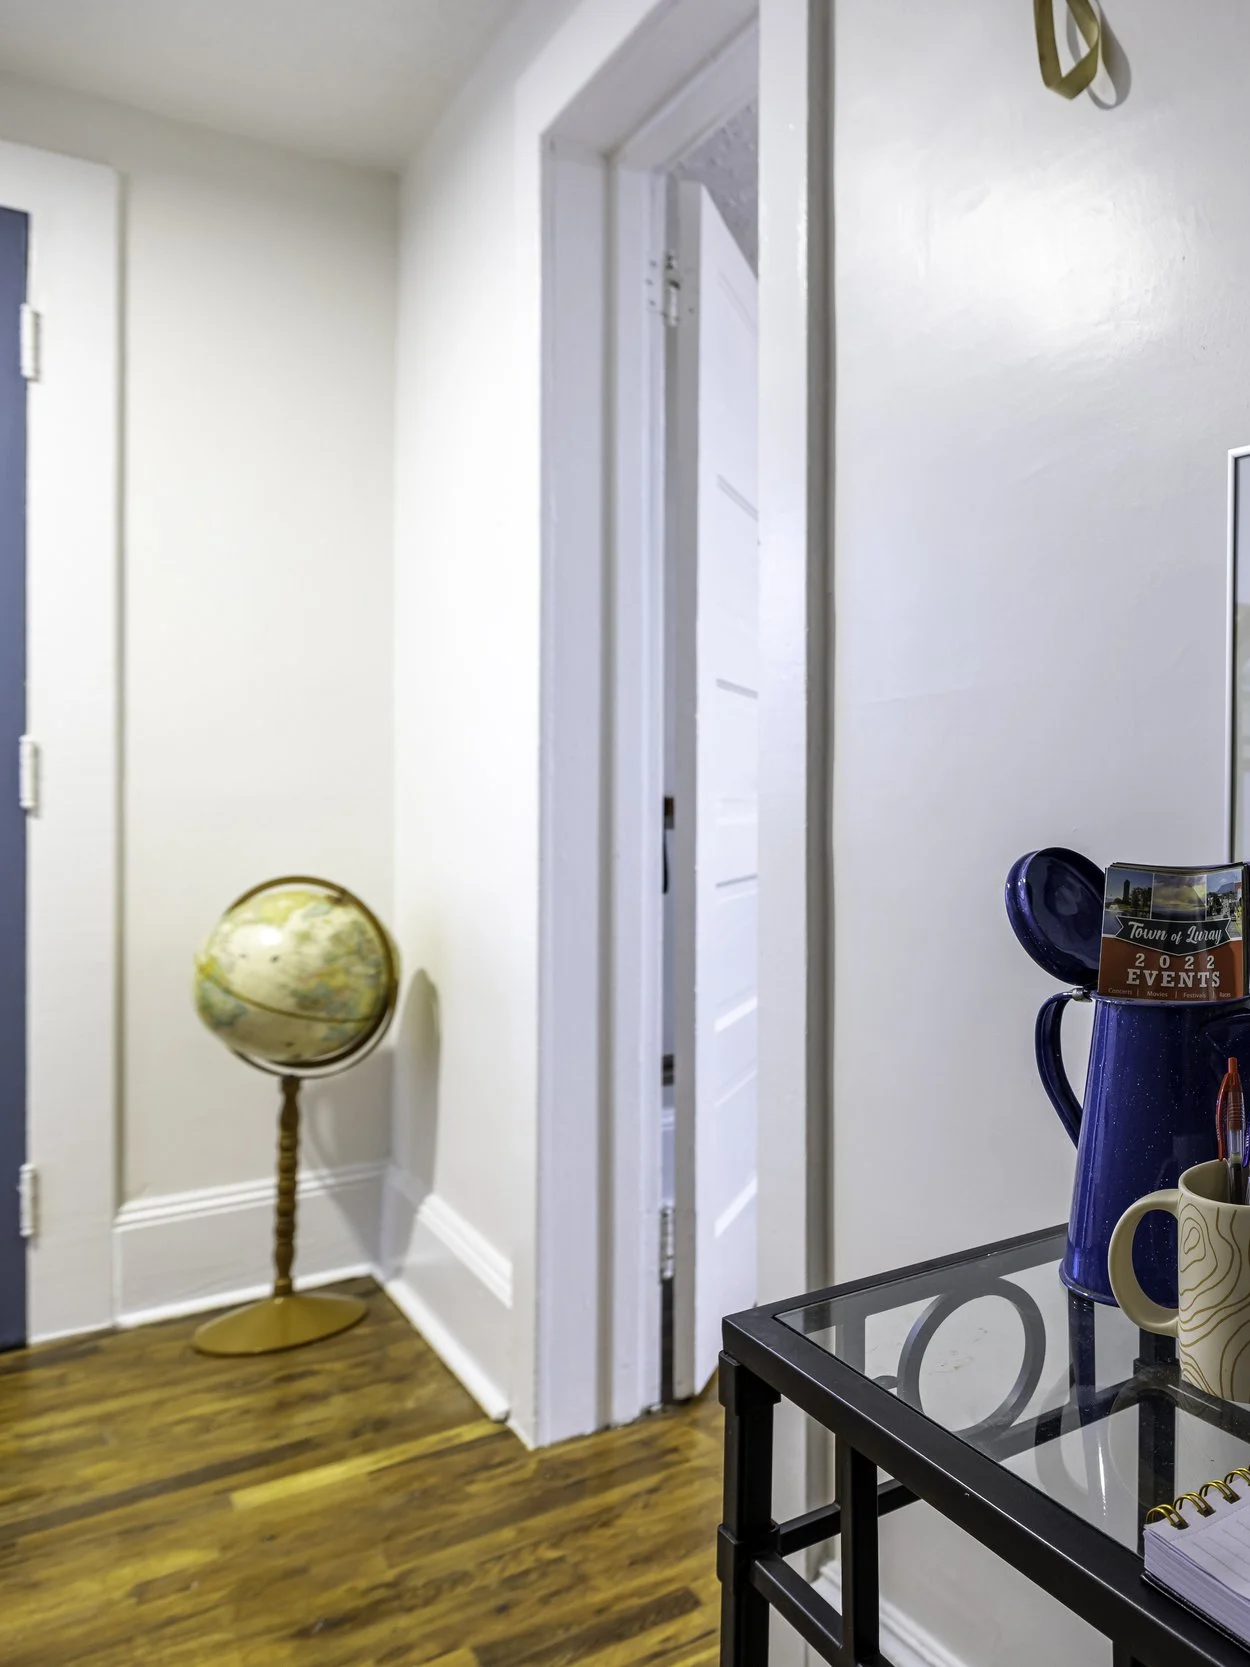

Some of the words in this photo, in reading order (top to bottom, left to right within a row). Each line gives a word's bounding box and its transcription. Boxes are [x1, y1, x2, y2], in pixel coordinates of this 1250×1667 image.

[1128, 922, 1166, 939] Town
[1171, 932, 1182, 944] of
[1186, 926, 1222, 944] Luray
[1135, 953, 1215, 969] 2022
[1127, 969, 1220, 988] EVENTS
[1108, 987, 1132, 995] Concerts
